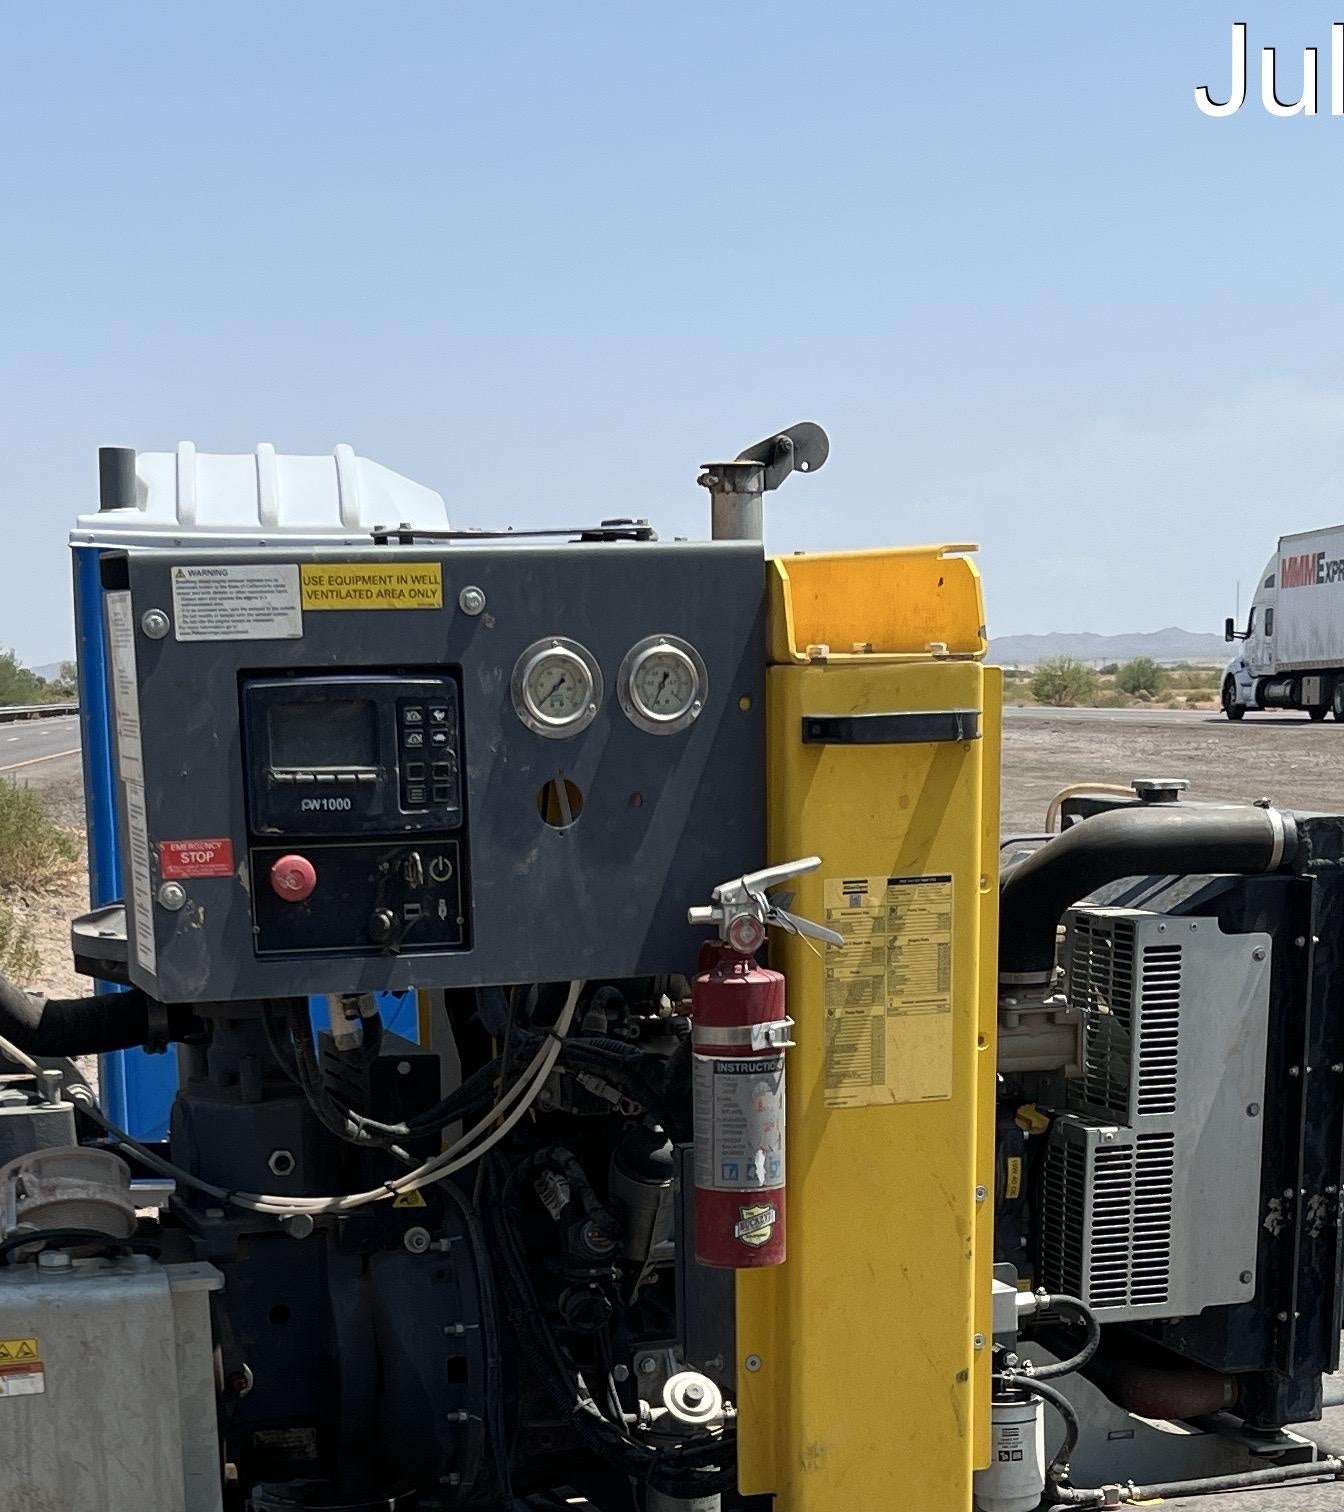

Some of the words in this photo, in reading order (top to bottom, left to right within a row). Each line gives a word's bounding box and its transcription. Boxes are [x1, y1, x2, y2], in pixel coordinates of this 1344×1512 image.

[188, 568, 228, 577] WARNING
[303, 575, 325, 586] USE
[328, 575, 394, 586] EQUIPMENT
[397, 575, 408, 585] IN
[410, 574, 440, 585] WELL
[306, 589, 374, 600] VENTILATED
[376, 589, 406, 599] AREA
[408, 588, 438, 599] ONLY
[180, 851, 214, 864] STOP
